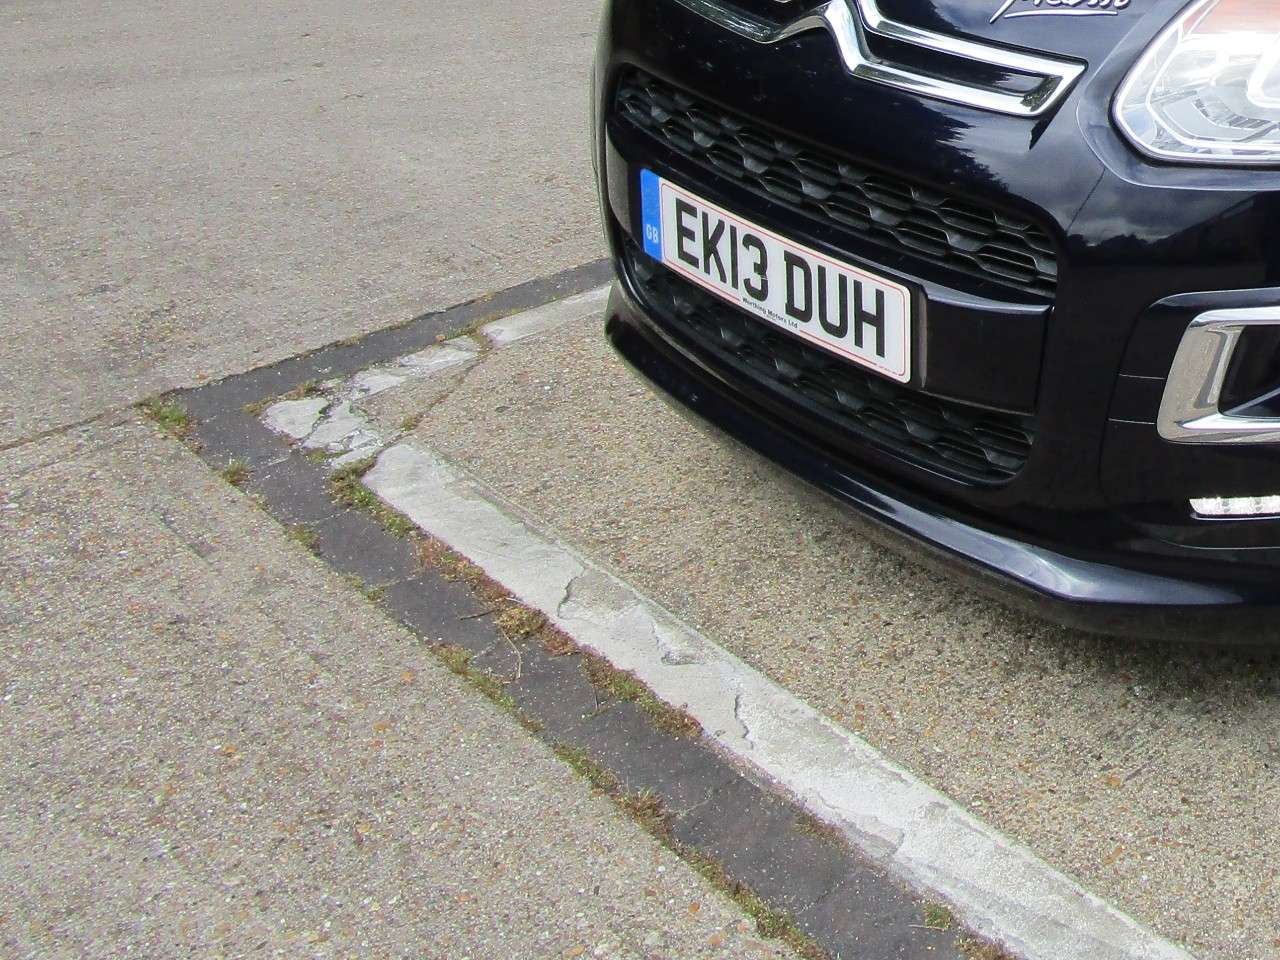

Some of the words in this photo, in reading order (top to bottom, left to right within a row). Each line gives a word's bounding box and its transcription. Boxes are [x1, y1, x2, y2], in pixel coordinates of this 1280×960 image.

[646, 223, 659, 244] GB
[675, 197, 768, 302] EK13
[783, 249, 885, 359] DUH
[767, 309, 787, 323] Motors
[788, 319, 798, 329] Ltd
